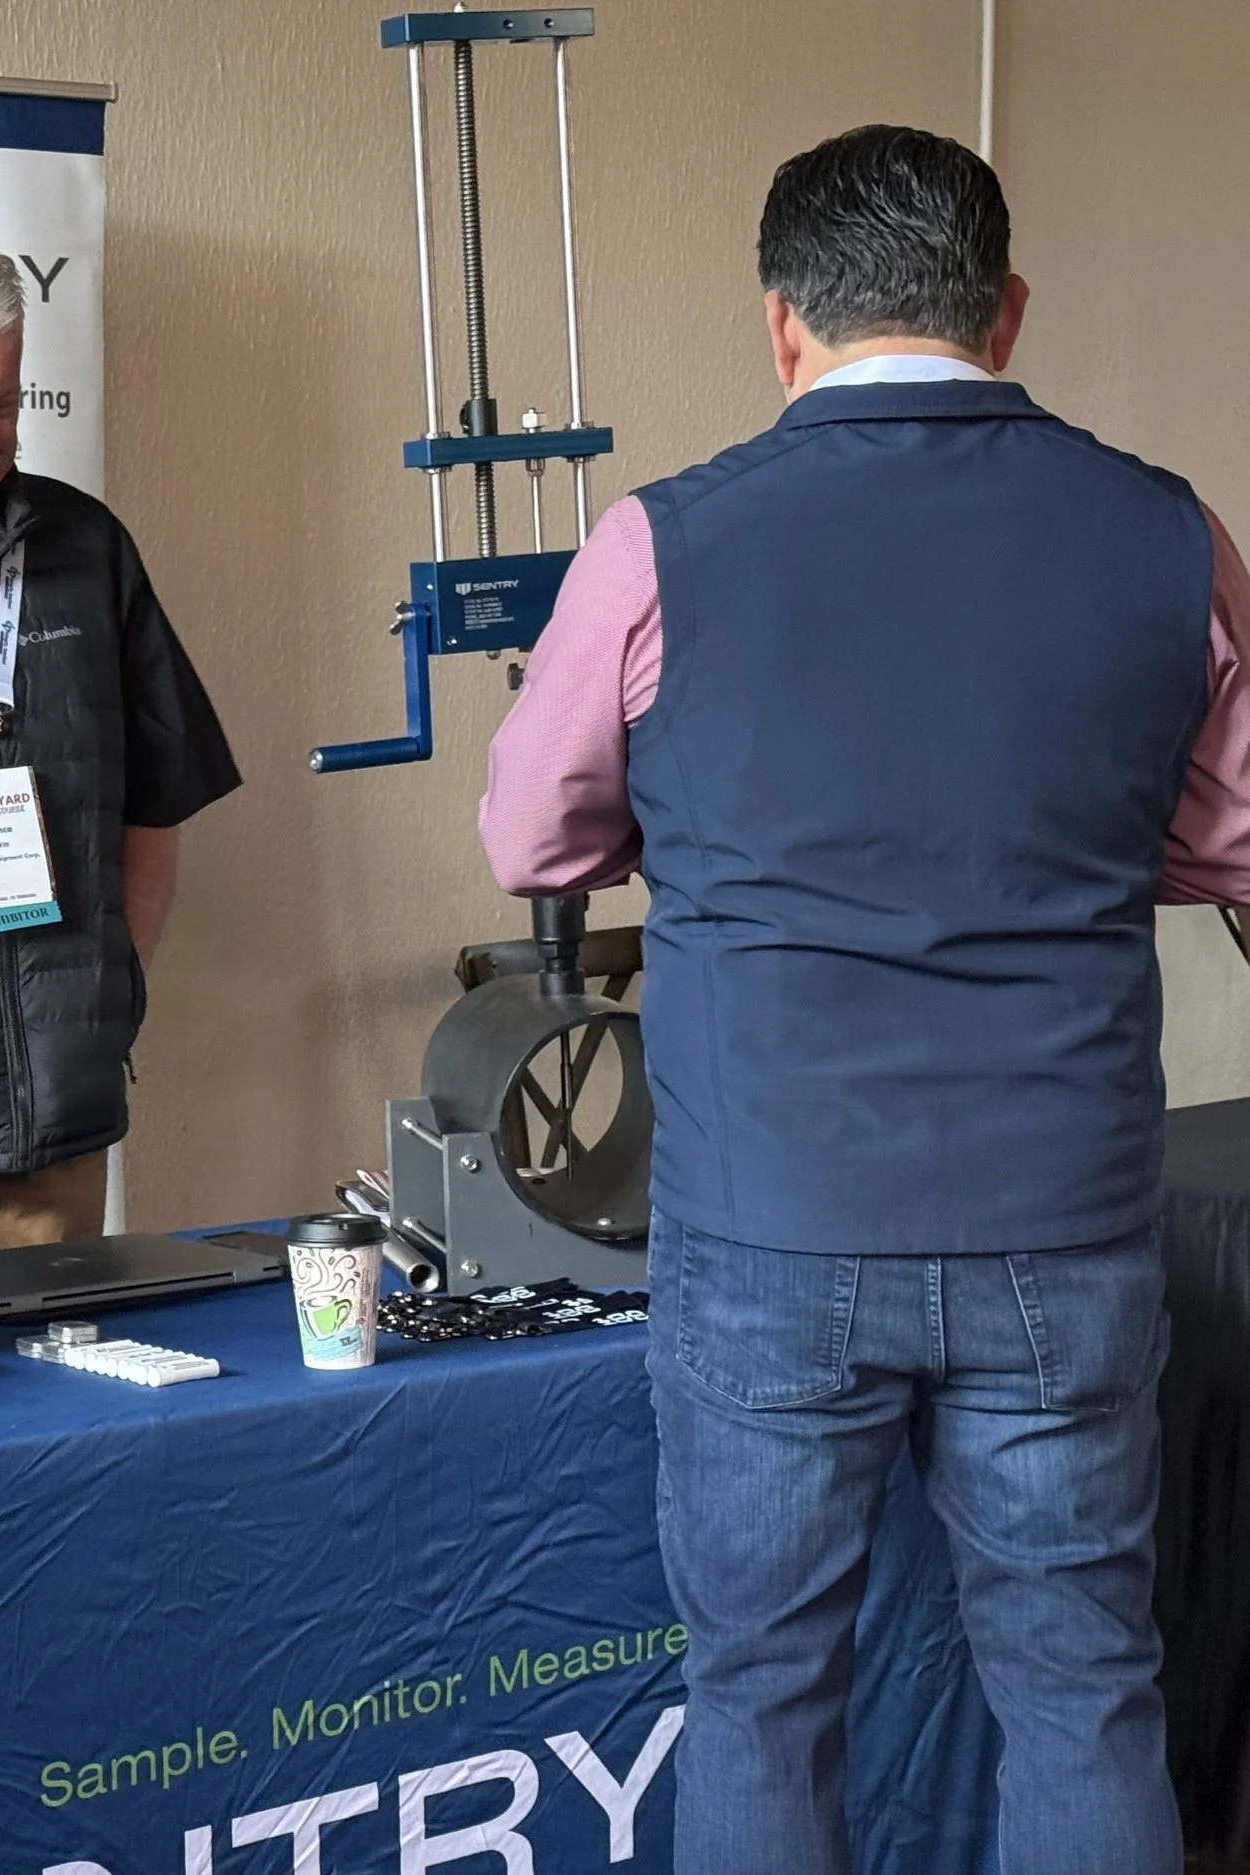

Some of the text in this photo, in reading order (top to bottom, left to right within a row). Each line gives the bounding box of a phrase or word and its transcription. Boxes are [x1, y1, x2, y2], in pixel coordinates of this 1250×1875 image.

[472, 579, 519, 591] SENTRY
[28, 625, 82, 643] Columbia
[41, 1726, 249, 1807] Sample.
[271, 1673, 467, 1751] Monitor.
